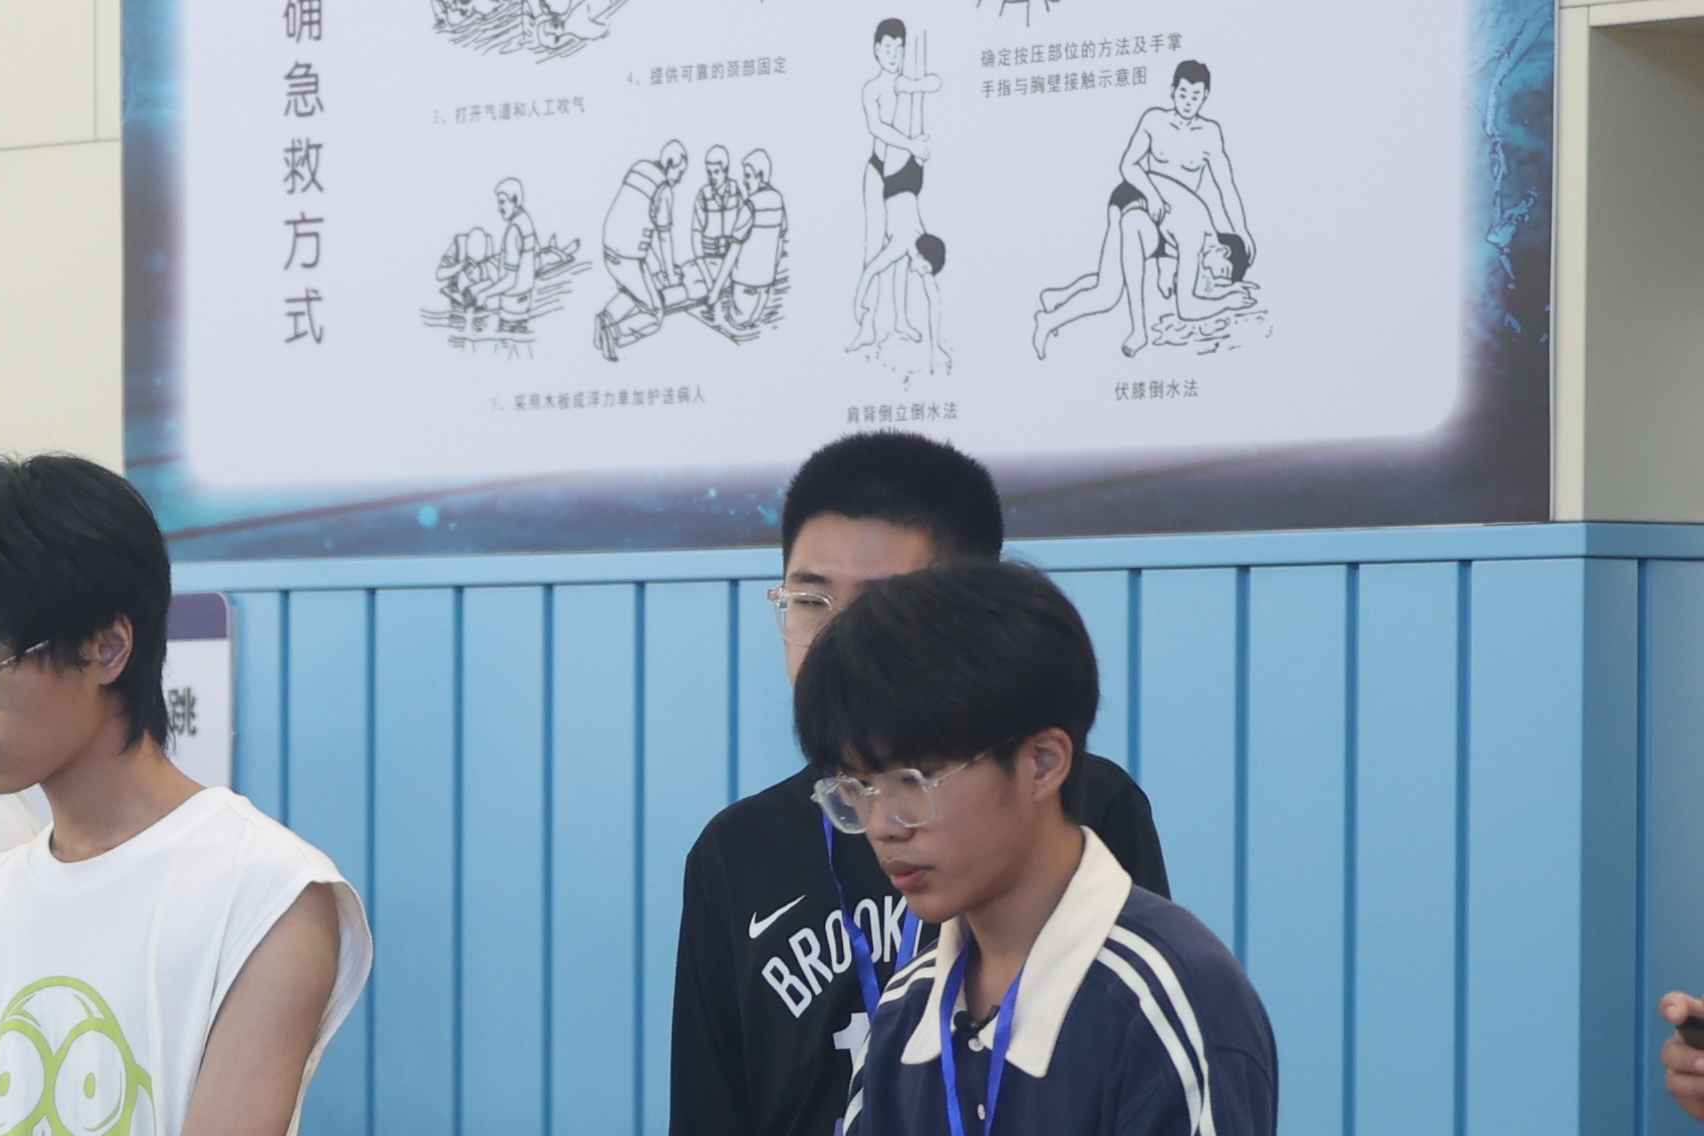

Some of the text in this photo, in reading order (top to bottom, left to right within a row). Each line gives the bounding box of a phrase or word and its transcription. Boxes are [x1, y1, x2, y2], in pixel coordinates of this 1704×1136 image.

[980, 32, 1183, 67] 确定按压部位的方法及手掌
[980, 66, 1147, 98] 手指与胸壁接触示意图
[1114, 379, 1199, 401] 伏膝倒水法
[846, 402, 958, 424] 肩背倒立倒水法
